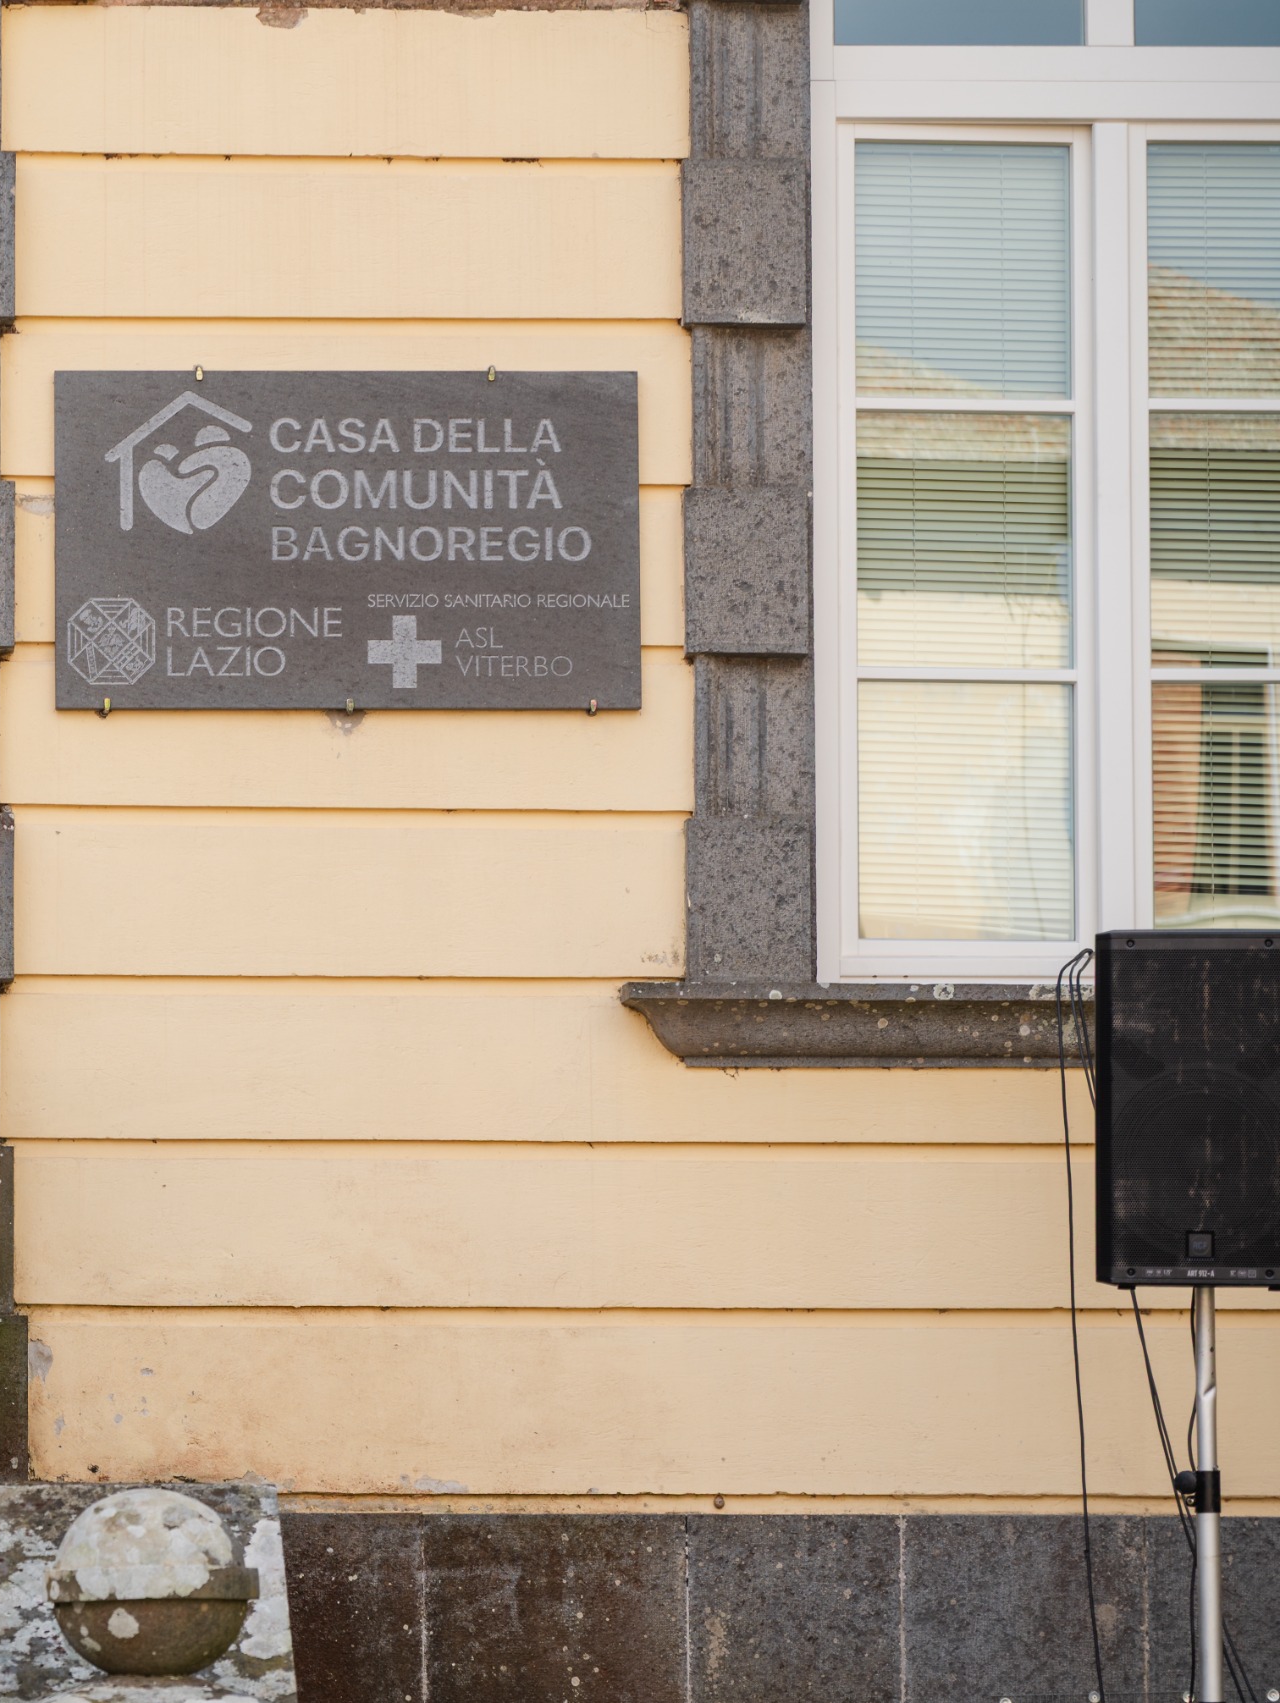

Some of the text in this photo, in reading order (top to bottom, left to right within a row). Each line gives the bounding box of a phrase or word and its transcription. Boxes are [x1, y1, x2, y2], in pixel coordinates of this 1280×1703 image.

[269, 418, 562, 453] CASA DELLA
[269, 458, 563, 510] COMUNITÀ
[271, 525, 592, 562] BAGNOREGIO
[367, 593, 630, 608] SERVIZIO SANITARIO REGIONALE
[166, 606, 343, 638] REGIONE
[455, 627, 504, 649] ASL
[166, 646, 287, 677] LAZIO
[455, 655, 574, 677] VITERBO
[1187, 1269, 1198, 1278] ART
